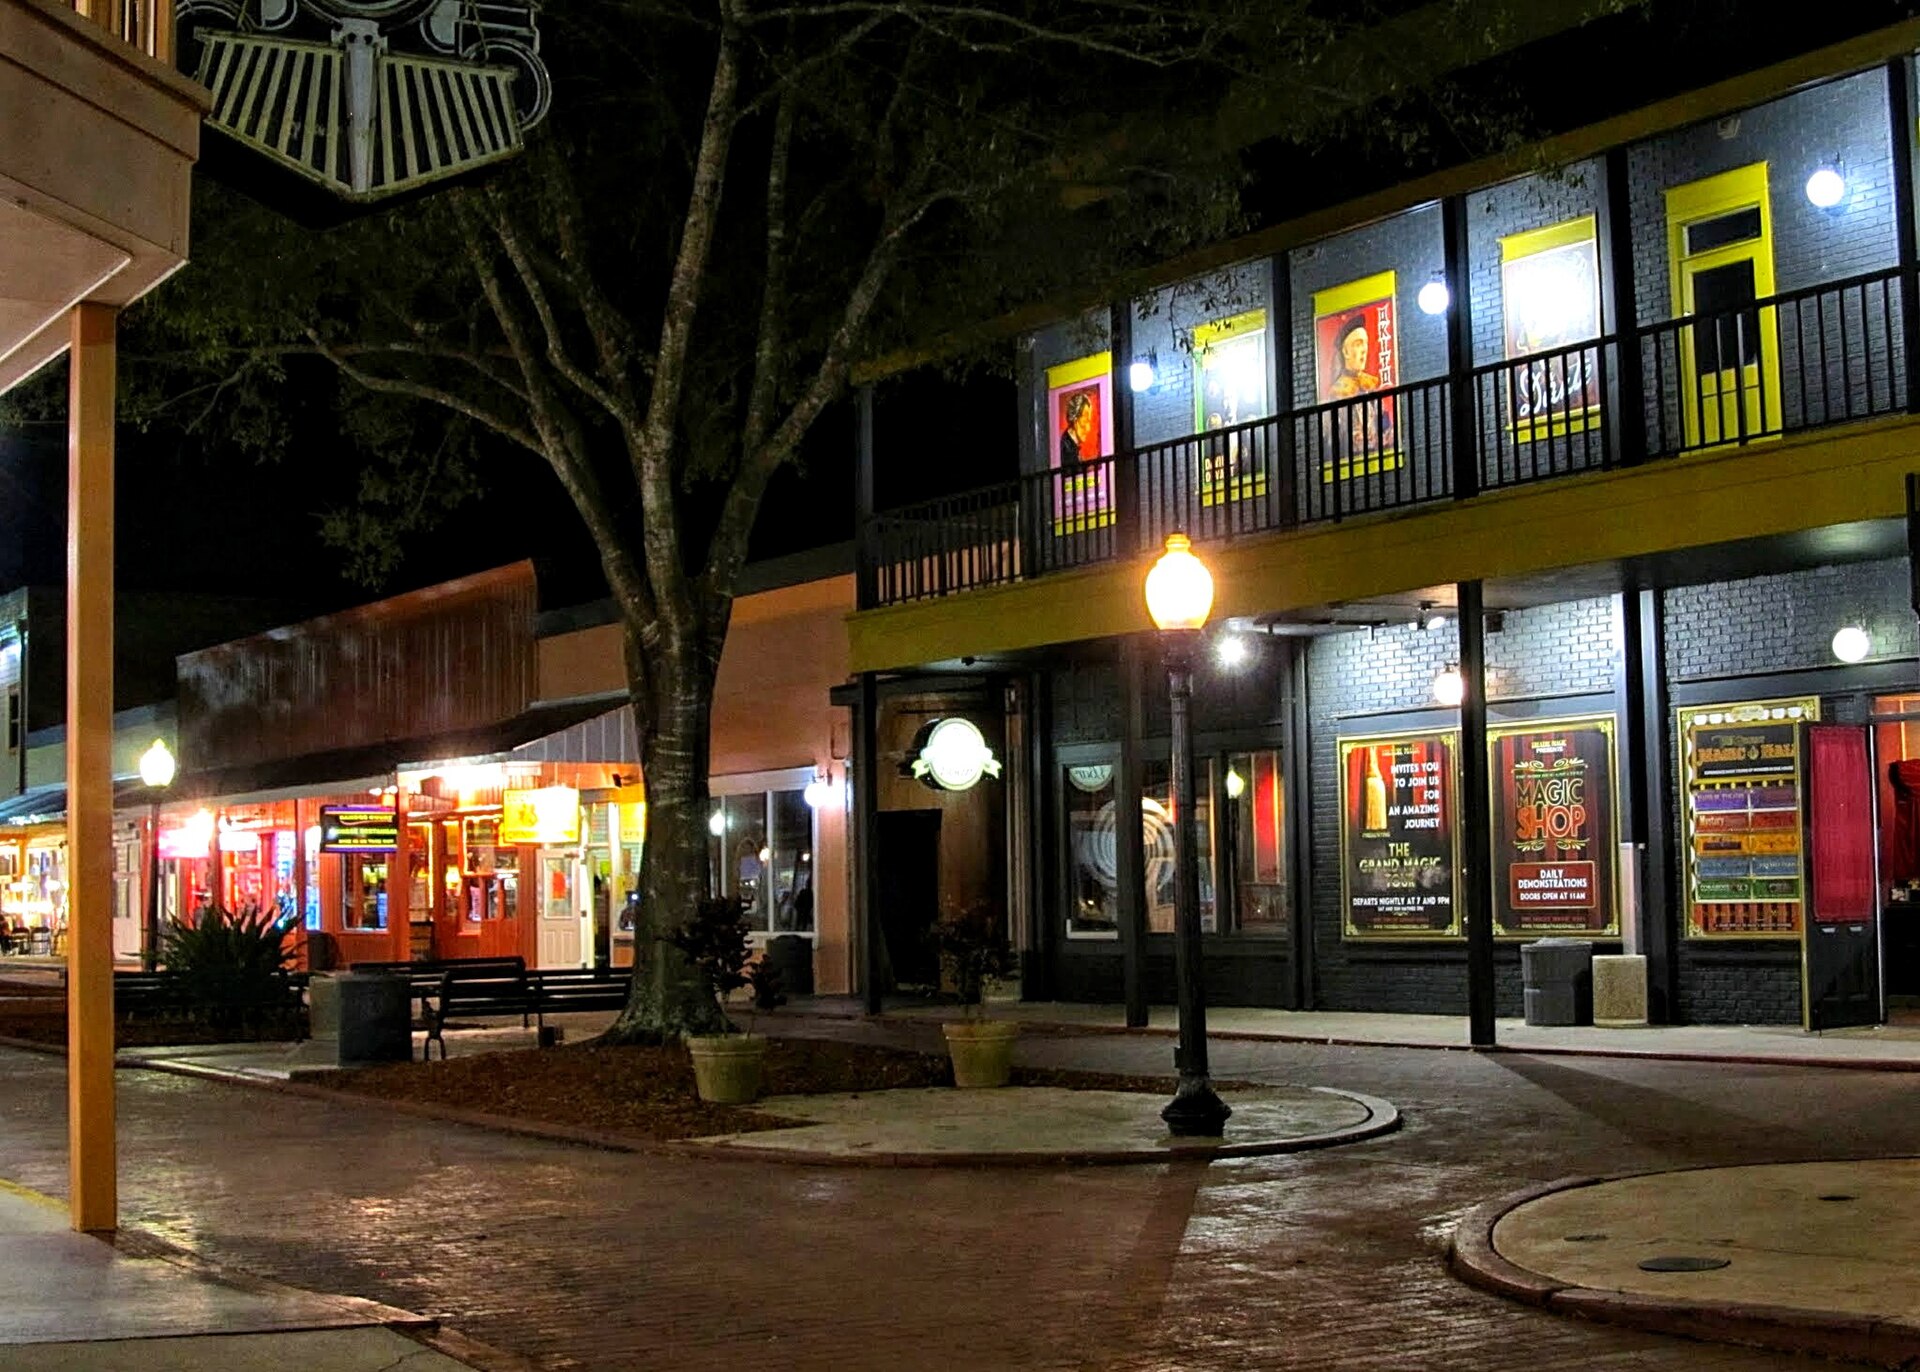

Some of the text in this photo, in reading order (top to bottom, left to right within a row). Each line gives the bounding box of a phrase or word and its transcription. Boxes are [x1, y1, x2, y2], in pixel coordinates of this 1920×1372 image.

[1377, 302, 1393, 388] OKITO
[1391, 762, 1439, 774] INVITES YOU
[1395, 776, 1439, 788] TO JOIN US
[1423, 790, 1440, 800] FOR
[1515, 778, 1584, 808] MAGIC
[1388, 804, 1440, 816] AN AMAZING
[1404, 818, 1440, 829] JOURNEY
[1516, 804, 1587, 840] SHOP
[1388, 842, 1410, 857] THE
[1359, 857, 1441, 873] GRAND MAGIC
[1540, 869, 1564, 879] DAILY
[1384, 873, 1416, 888] TOUR
[1518, 878, 1588, 889] DEMONSTRATIONS
[1352, 896, 1450, 906] DEPARTS NIGHTLY AT 7 AND 9PM
[1542, 892, 1558, 900] OPEN
[1559, 892, 1568, 900] AT
